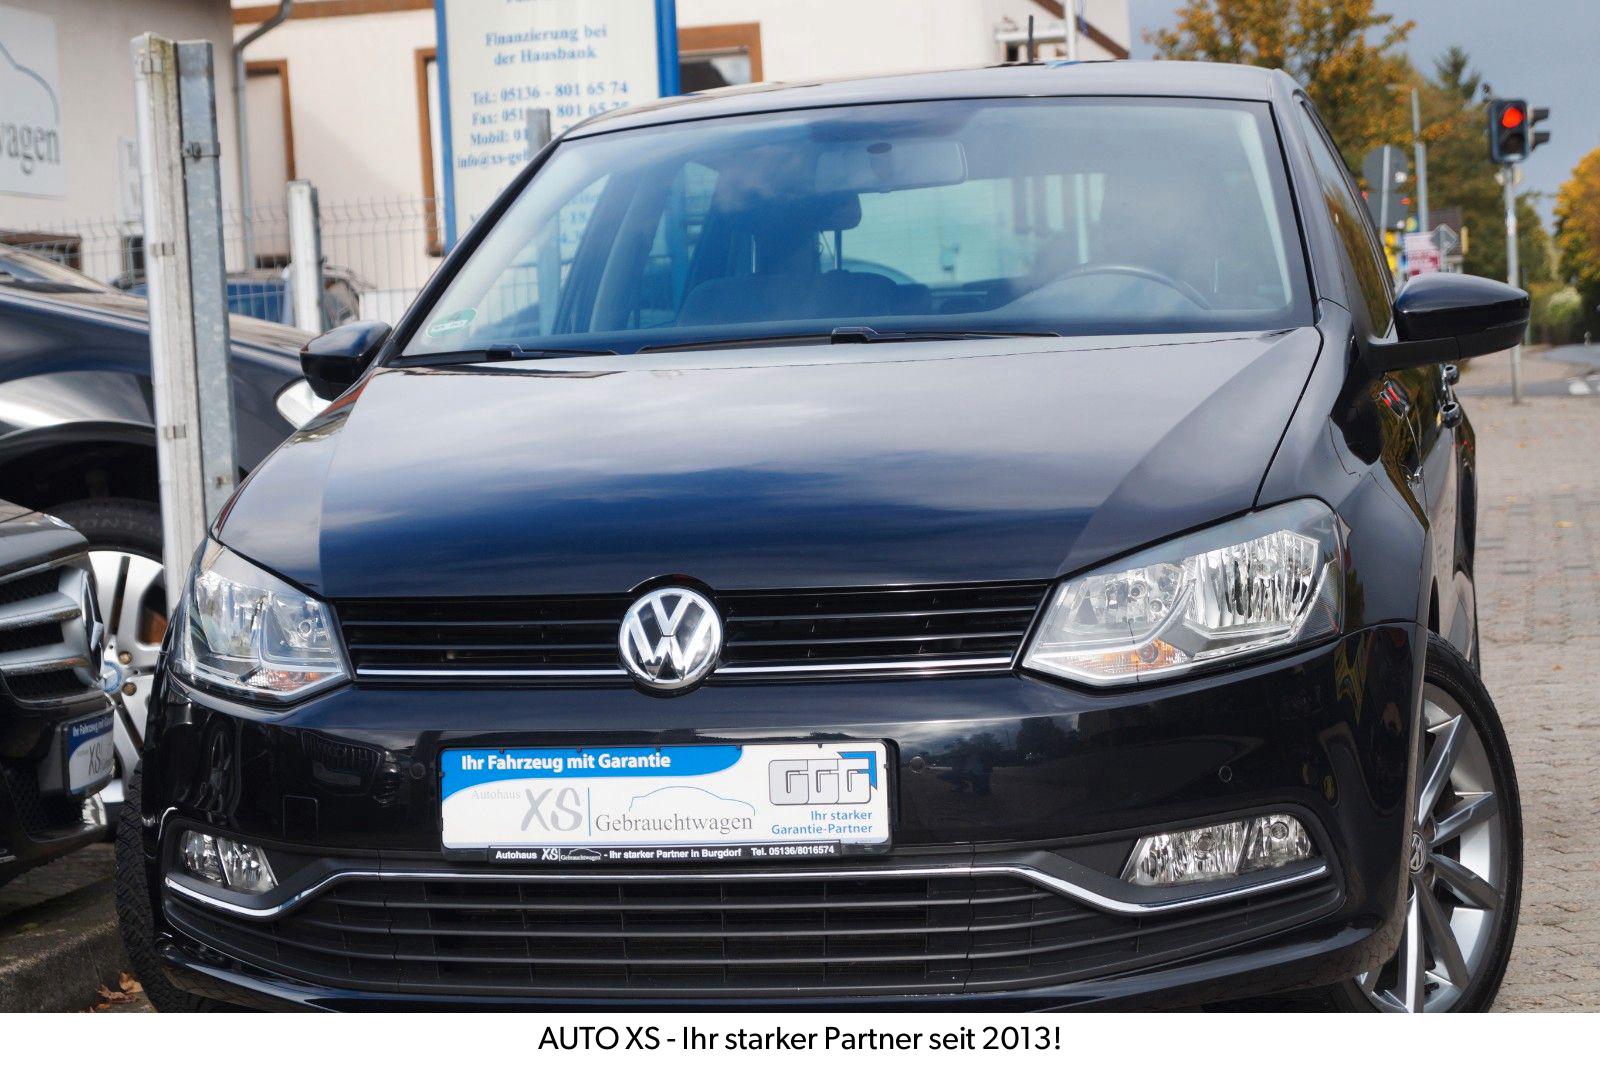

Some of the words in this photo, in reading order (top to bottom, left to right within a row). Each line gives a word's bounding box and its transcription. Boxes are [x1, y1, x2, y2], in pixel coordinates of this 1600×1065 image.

[485, 28, 578, 46] Finanzierung
[584, 24, 608, 38] bei
[494, 53, 515, 65] der
[521, 47, 597, 62] Hausbank
[500, 86, 539, 101] 05136
[555, 83, 580, 97] 801
[587, 81, 605, 96] 65
[611, 80, 629, 94] 74
[556, 103, 582, 117] 801
[461, 755, 484, 770] Ihr
[488, 755, 563, 773] Fahrzeug
[567, 754, 595, 769] mit
[598, 753, 671, 769] Garantie
[471, 788, 521, 800] Autohaus
[520, 787, 583, 832] XS
[811, 811, 827, 820] Ihr
[830, 810, 872, 820] starker
[595, 813, 753, 835] Gebrauchtwagen
[771, 824, 873, 835] Garantie-Partner
[496, 850, 537, 860] Autohaus
[541, 848, 559, 861] XS
[609, 850, 621, 859] Ihr
[623, 850, 654, 859] starker
[656, 848, 688, 859] Partner
[691, 849, 700, 858] in
[701, 848, 742, 860] Burgdorf
[751, 847, 767, 857] Tel.
[768, 845, 835, 856] 05136/8016574
